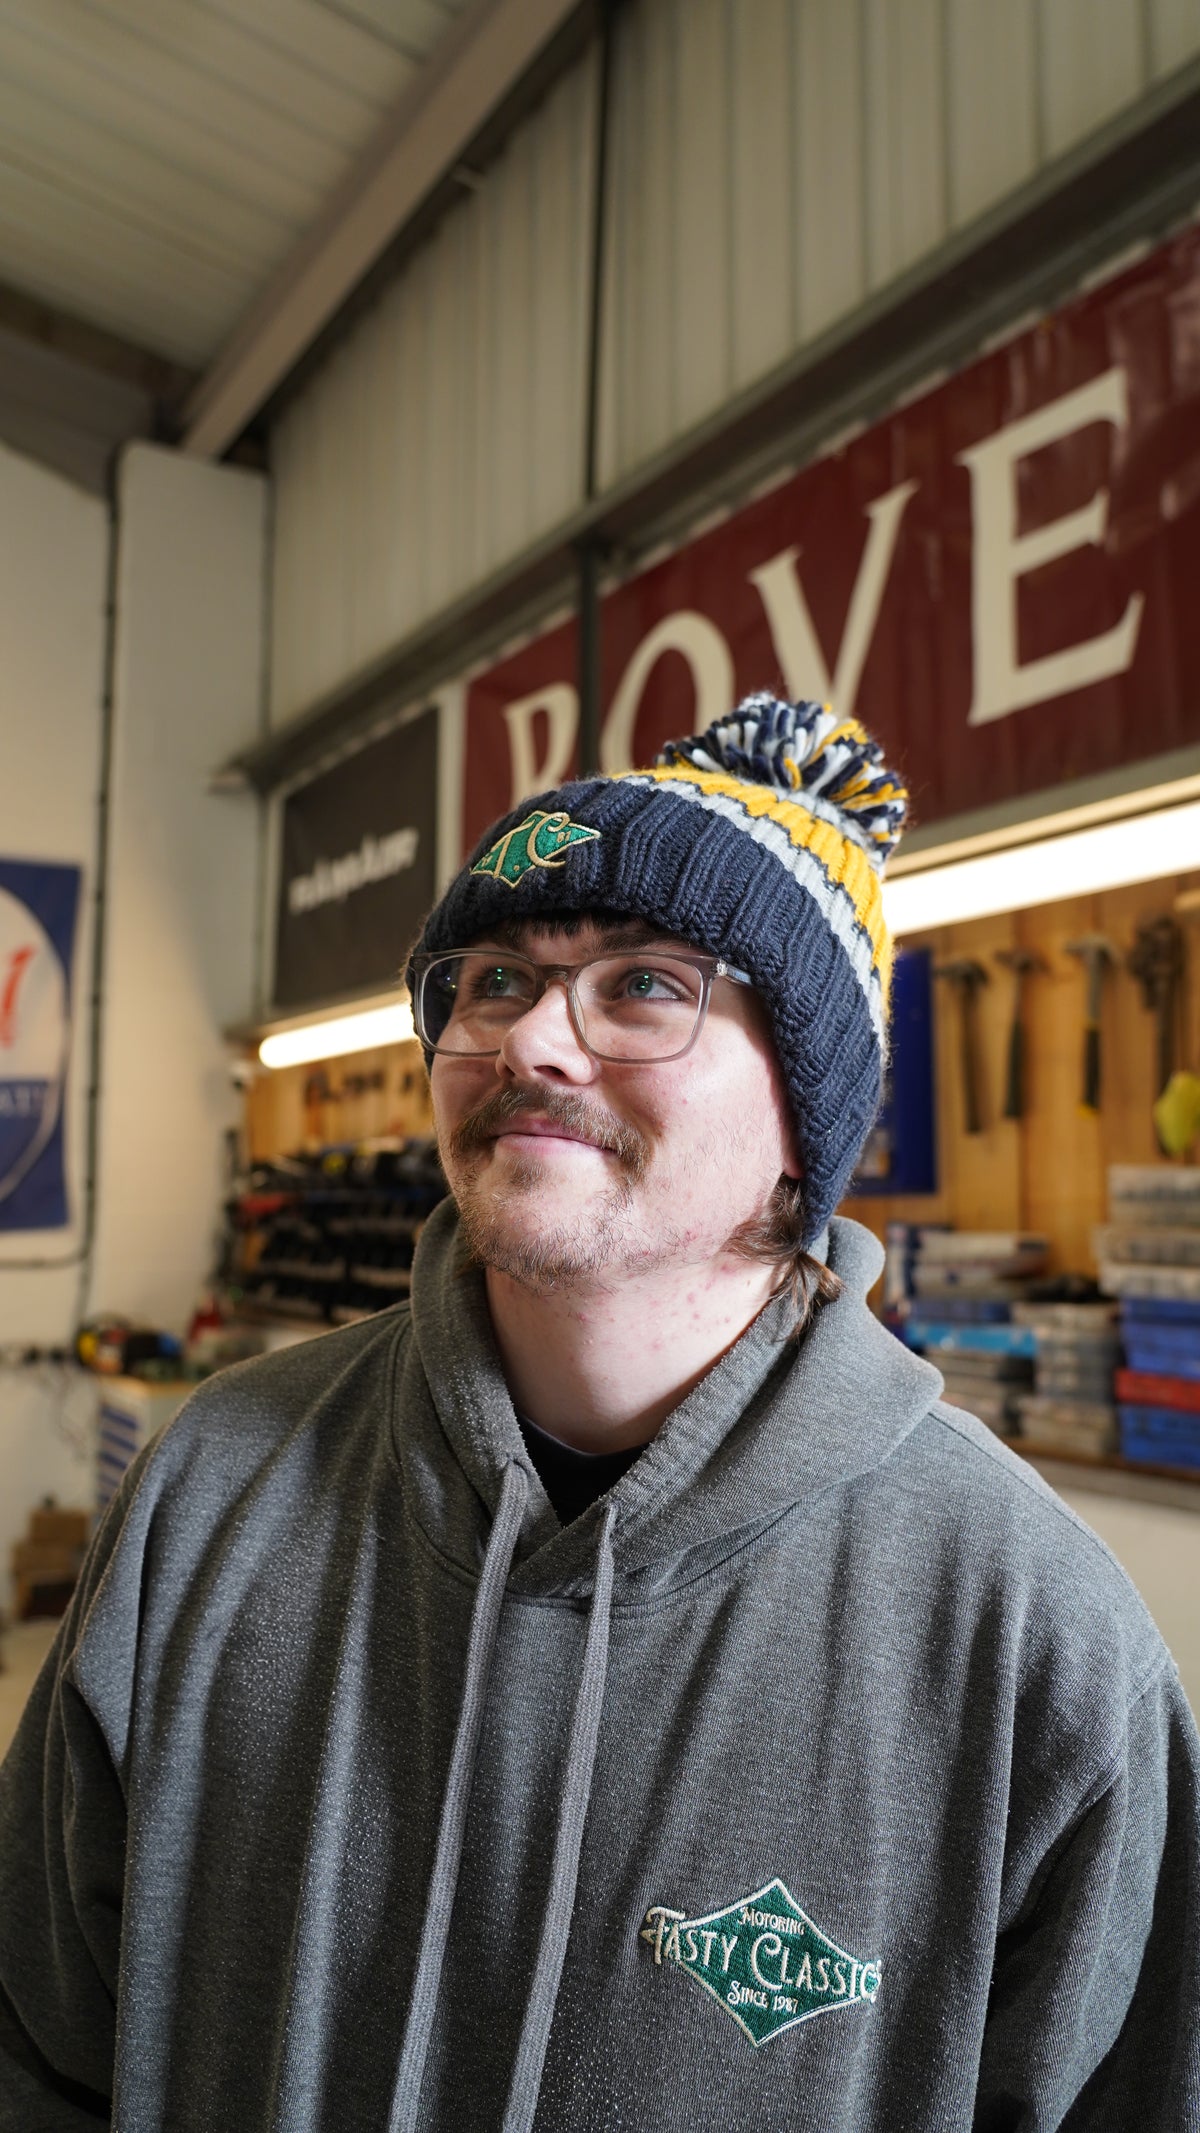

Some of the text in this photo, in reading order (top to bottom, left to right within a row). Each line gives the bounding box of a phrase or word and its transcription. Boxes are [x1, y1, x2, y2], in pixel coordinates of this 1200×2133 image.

[738, 1905, 806, 1936] MOTORING
[645, 1906, 738, 1972] TASTY
[727, 1979, 799, 2014] SINCE 1987
